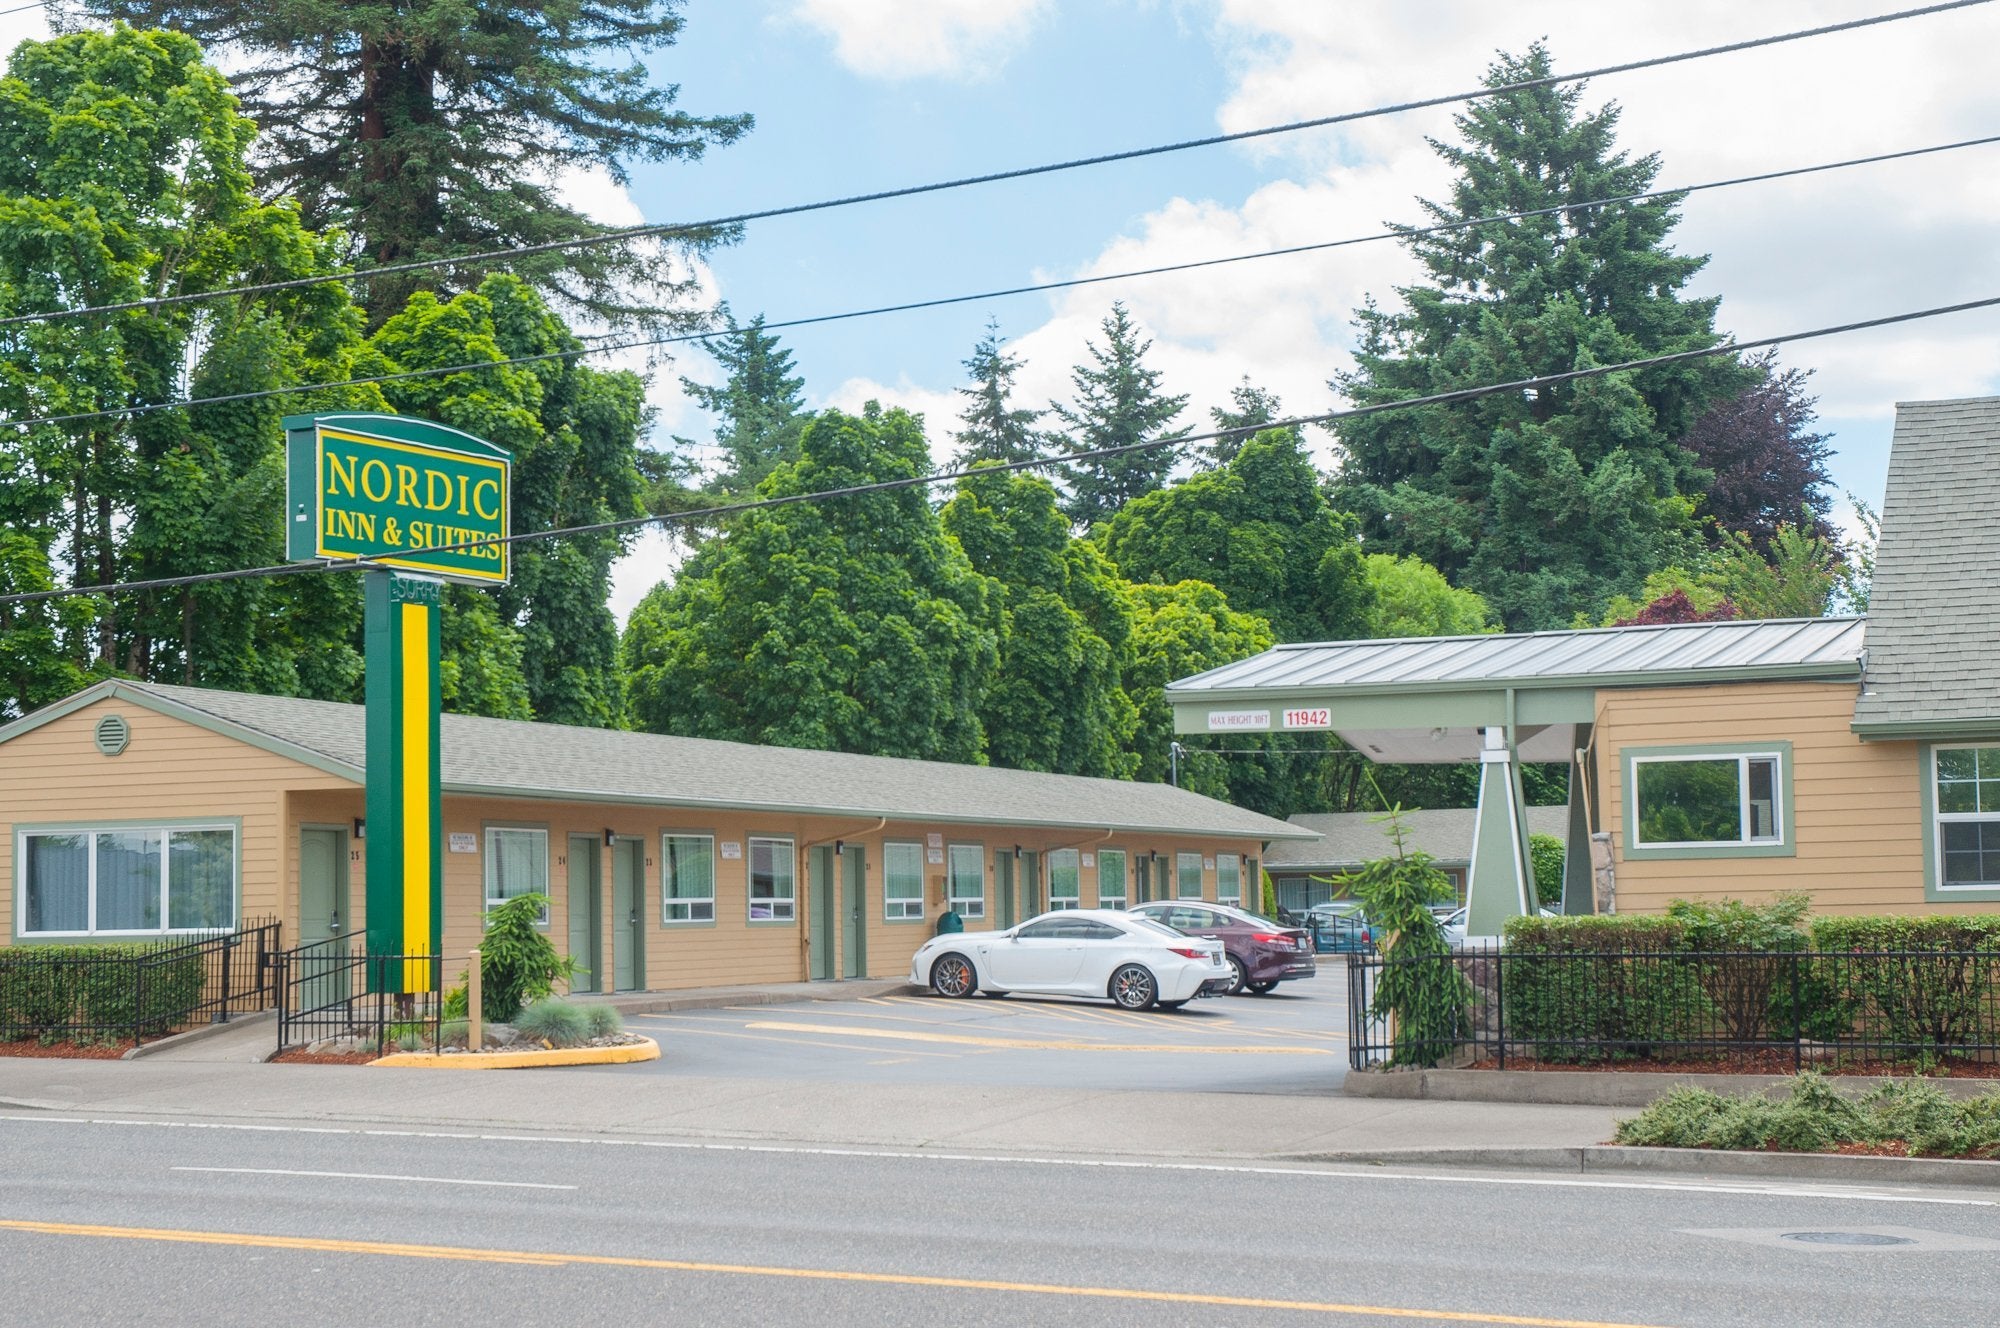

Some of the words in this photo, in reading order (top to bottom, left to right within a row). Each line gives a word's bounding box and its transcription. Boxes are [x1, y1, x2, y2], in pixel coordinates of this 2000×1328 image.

[326, 452, 499, 520] NORDIC
[325, 508, 376, 542] INN
[382, 517, 403, 546] &
[409, 521, 501, 560] SUITES
[397, 579, 441, 600] SORRY
[1211, 716, 1226, 725] MAX
[1228, 714, 1252, 725] HEIGHT
[1254, 713, 1268, 724] 10FT
[1287, 711, 1328, 725] 11942
[351, 850, 360, 861] 25
